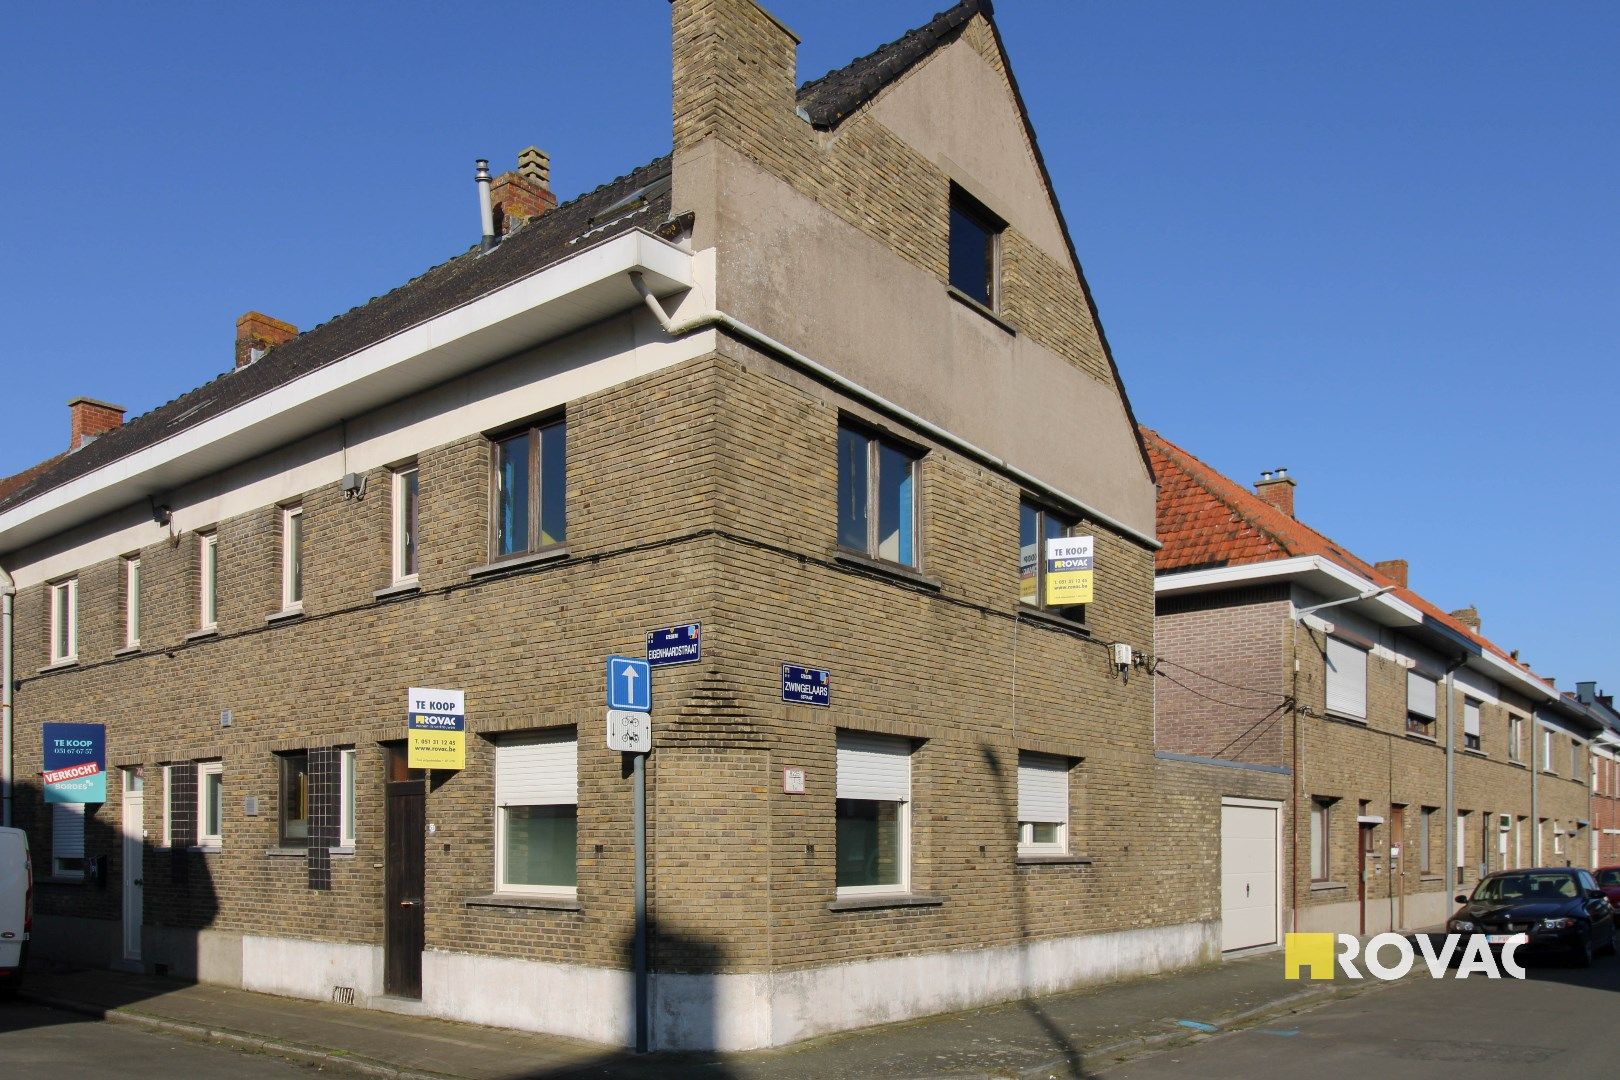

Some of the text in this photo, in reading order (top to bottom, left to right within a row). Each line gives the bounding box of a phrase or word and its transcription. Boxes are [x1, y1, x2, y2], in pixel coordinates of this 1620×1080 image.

[1066, 547, 1087, 555] KOOP
[1060, 559, 1087, 567] ROVAC
[649, 644, 697, 659] EIGENHAARDSTRAAT
[785, 682, 827, 696] ZWINGELAARS
[416, 701, 455, 711] TE KOOP
[424, 716, 455, 726] ROVAC
[45, 764, 97, 782] VERKOCHT
